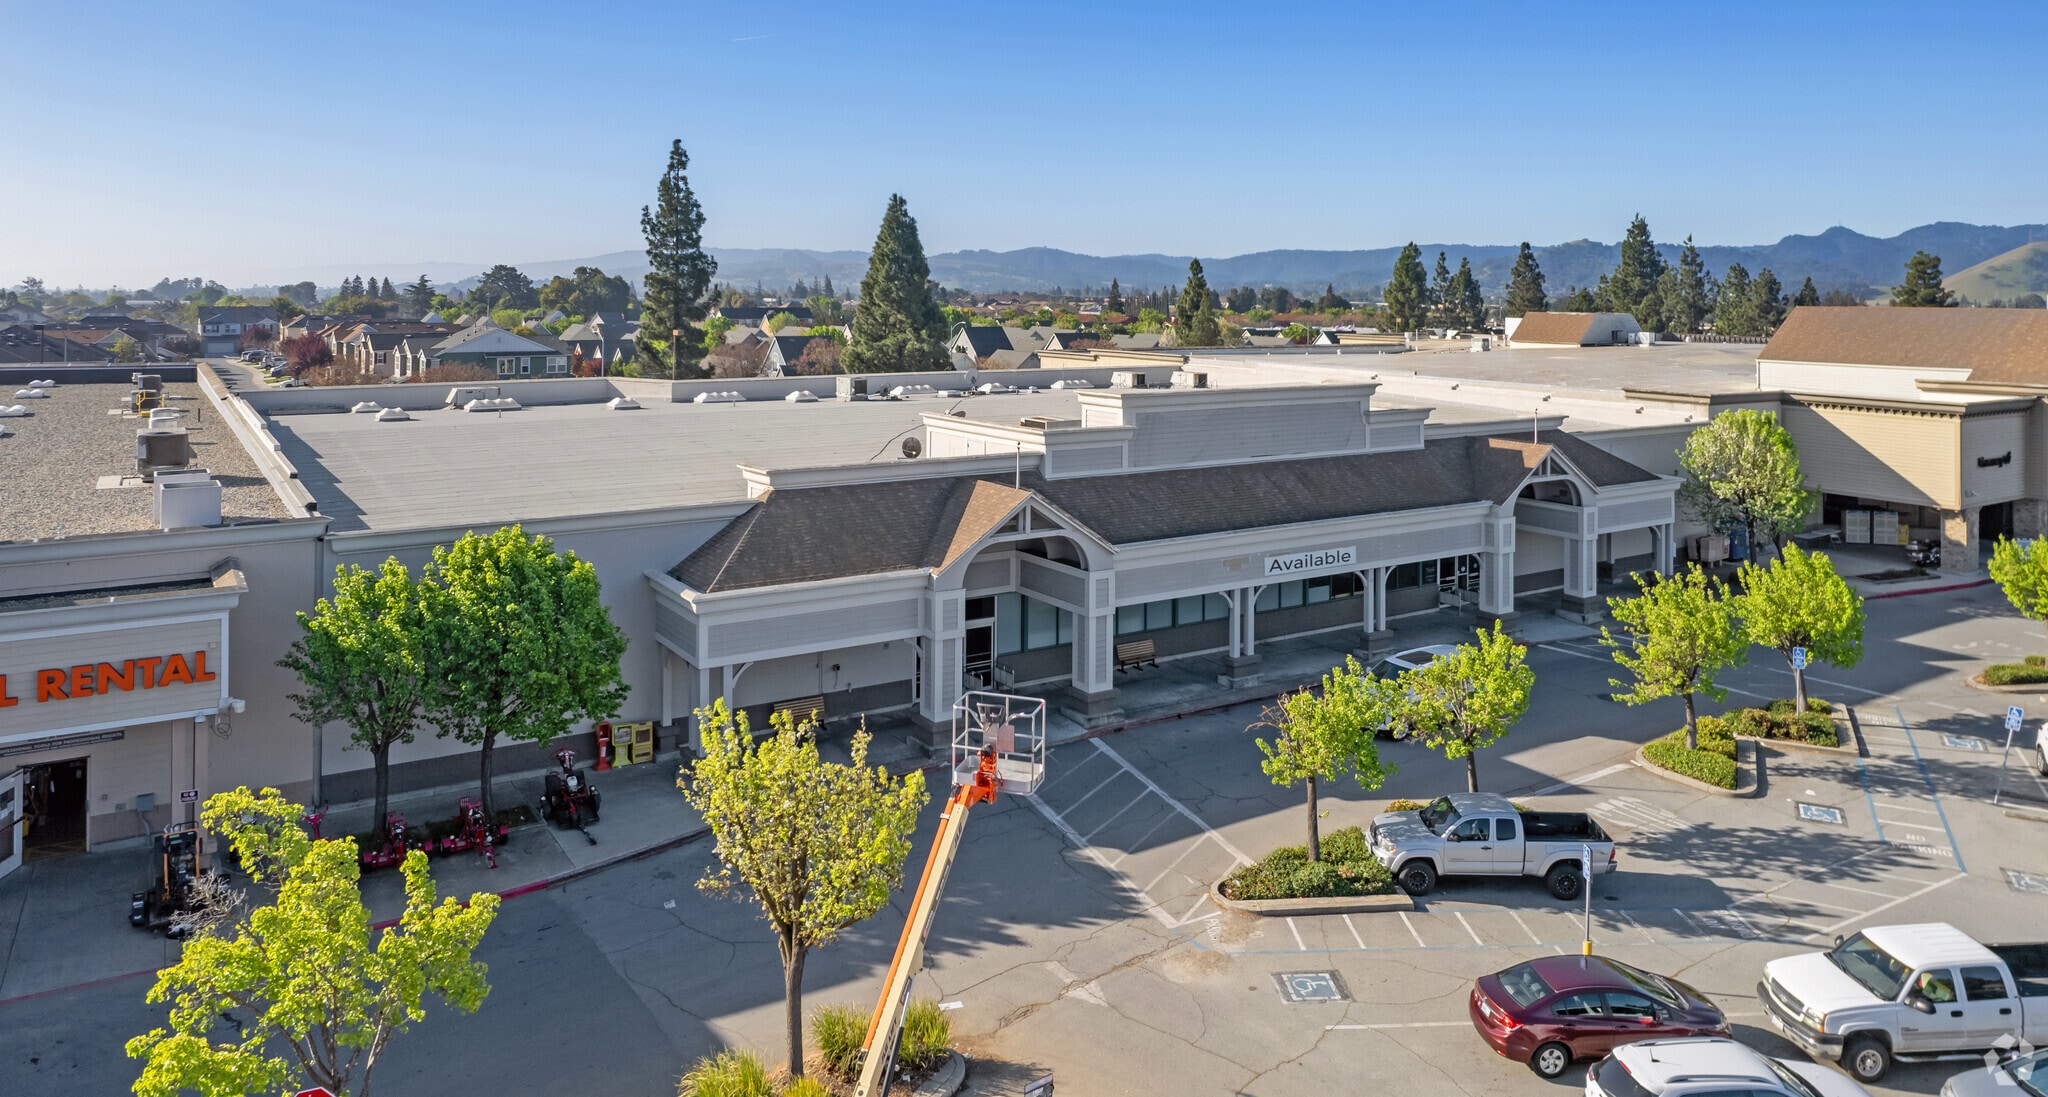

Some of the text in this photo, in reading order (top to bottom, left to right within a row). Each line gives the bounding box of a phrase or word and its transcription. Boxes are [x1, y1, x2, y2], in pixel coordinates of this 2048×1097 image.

[1269, 550, 1351, 573] Available
[37, 650, 216, 703] RENTAL
[1905, 833, 1926, 841] NO
[1891, 840, 1953, 857] PARKING
